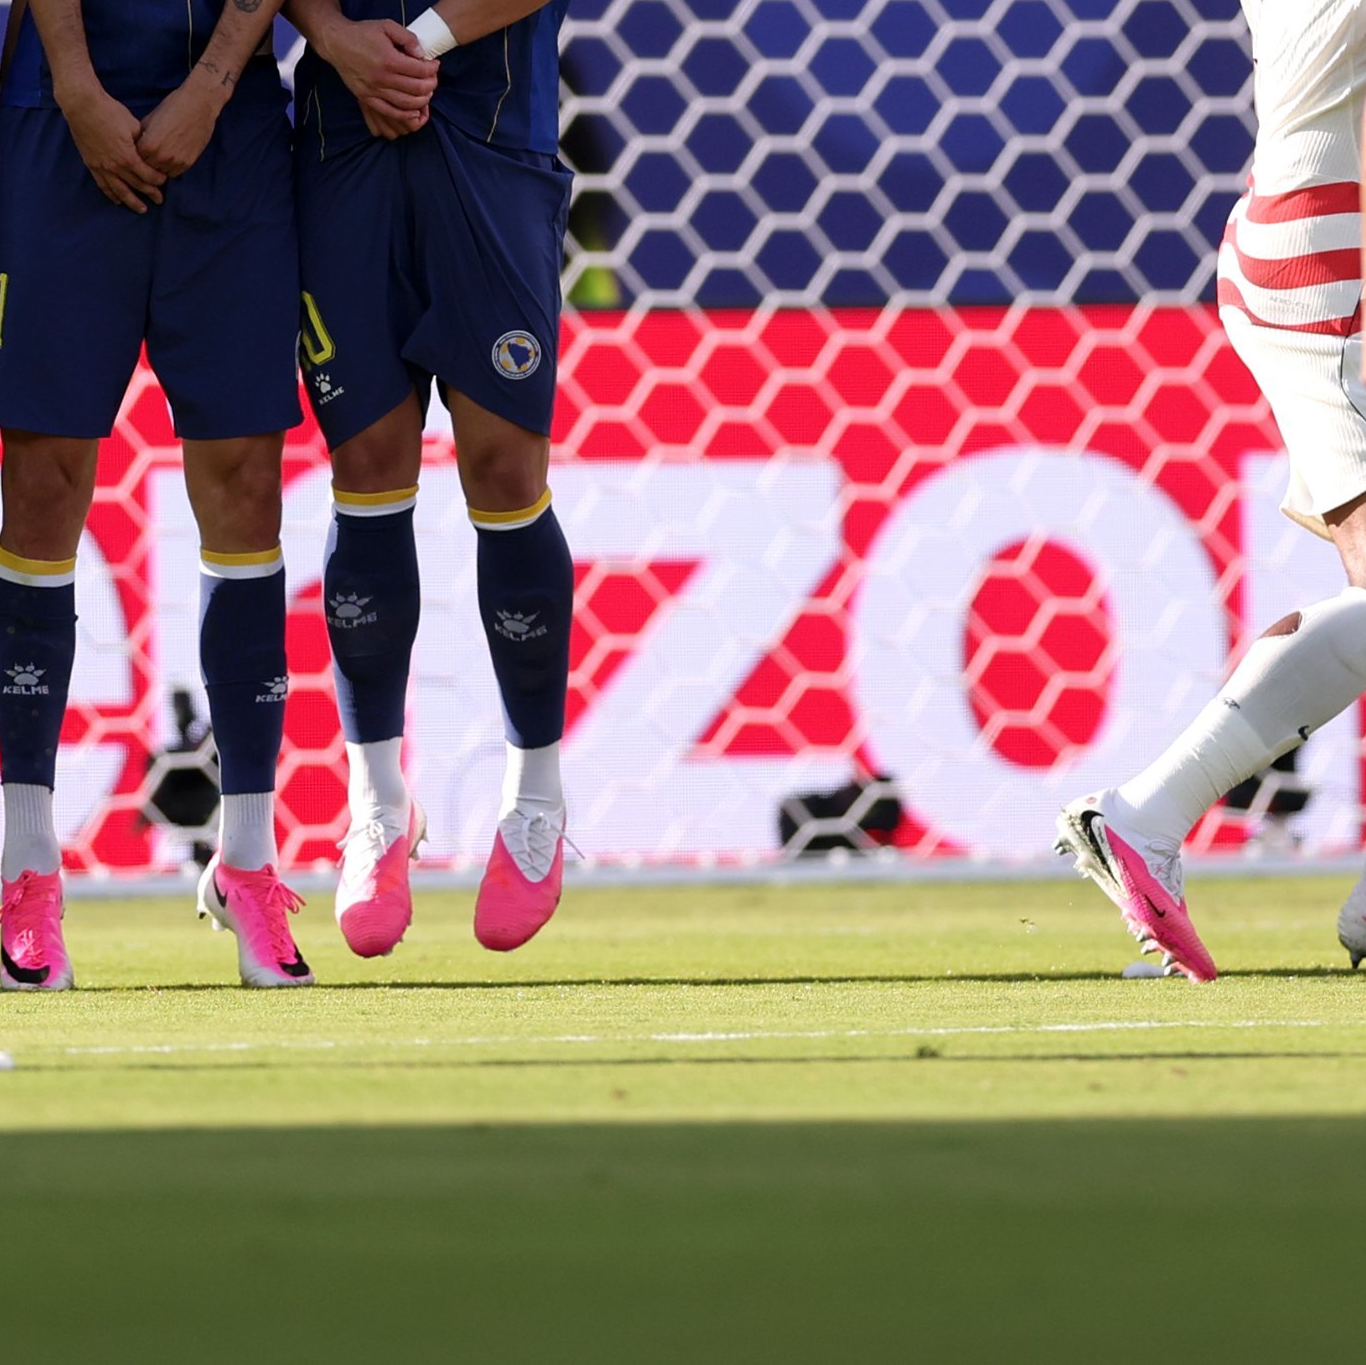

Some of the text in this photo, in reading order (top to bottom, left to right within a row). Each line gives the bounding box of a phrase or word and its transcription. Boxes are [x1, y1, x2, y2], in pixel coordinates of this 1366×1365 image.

[318, 386, 345, 405] KELME
[327, 611, 377, 629] KELME
[494, 622, 548, 642] KELME
[2, 685, 50, 696] KELME
[255, 693, 288, 703] KELM
